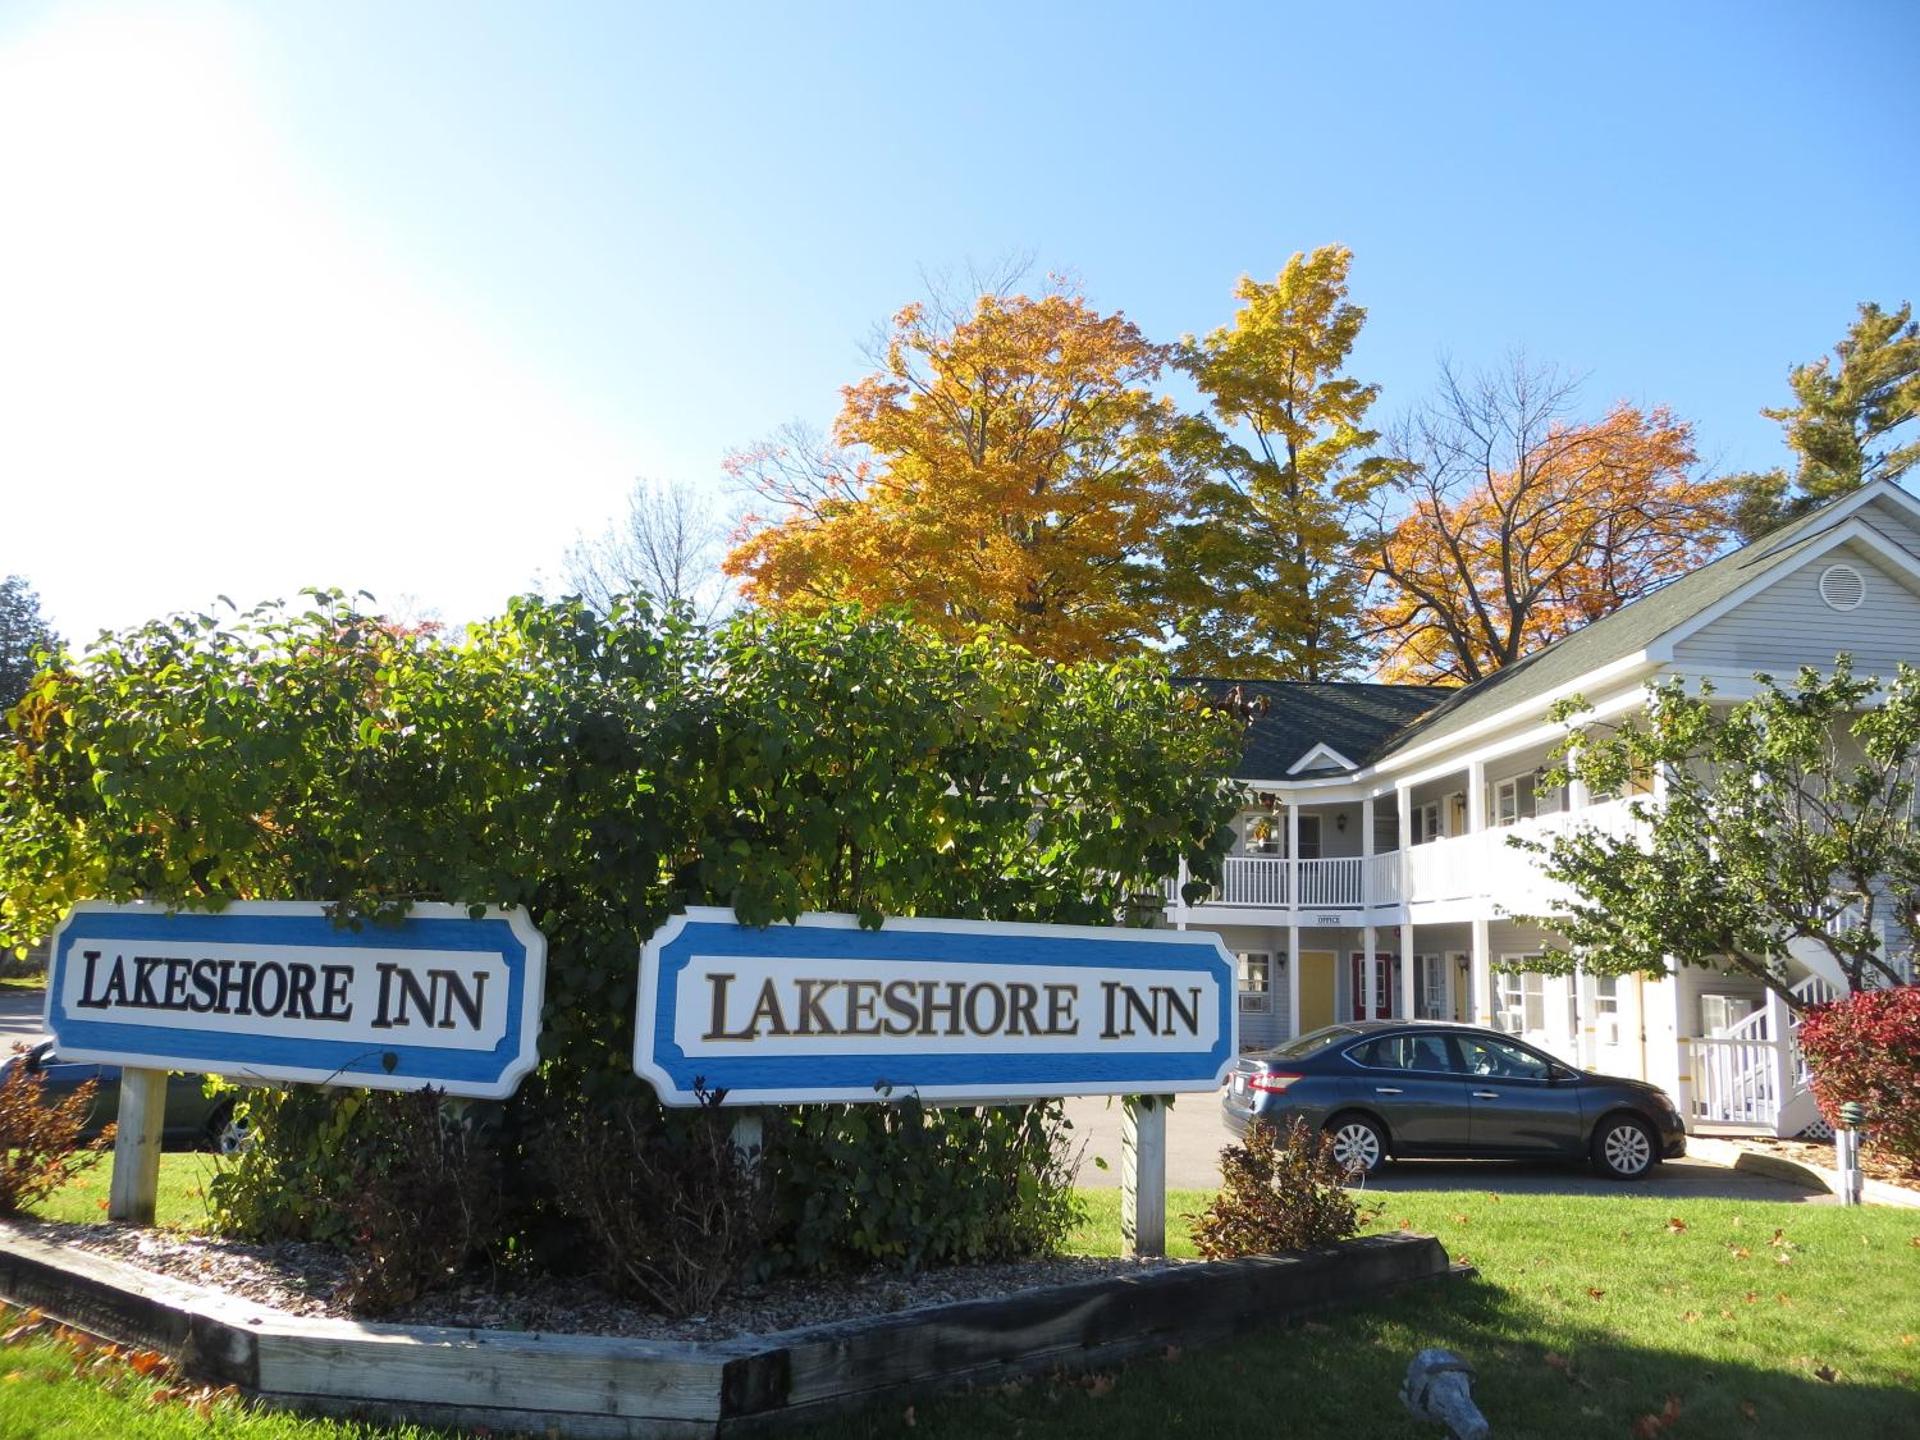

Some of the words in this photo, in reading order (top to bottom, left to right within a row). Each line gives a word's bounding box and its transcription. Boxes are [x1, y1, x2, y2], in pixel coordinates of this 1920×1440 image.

[77, 950, 354, 1022] LAKESHORE
[371, 962, 490, 1031] INN
[701, 972, 1080, 1042] LAKESHORE
[1099, 980, 1202, 1040] INN
